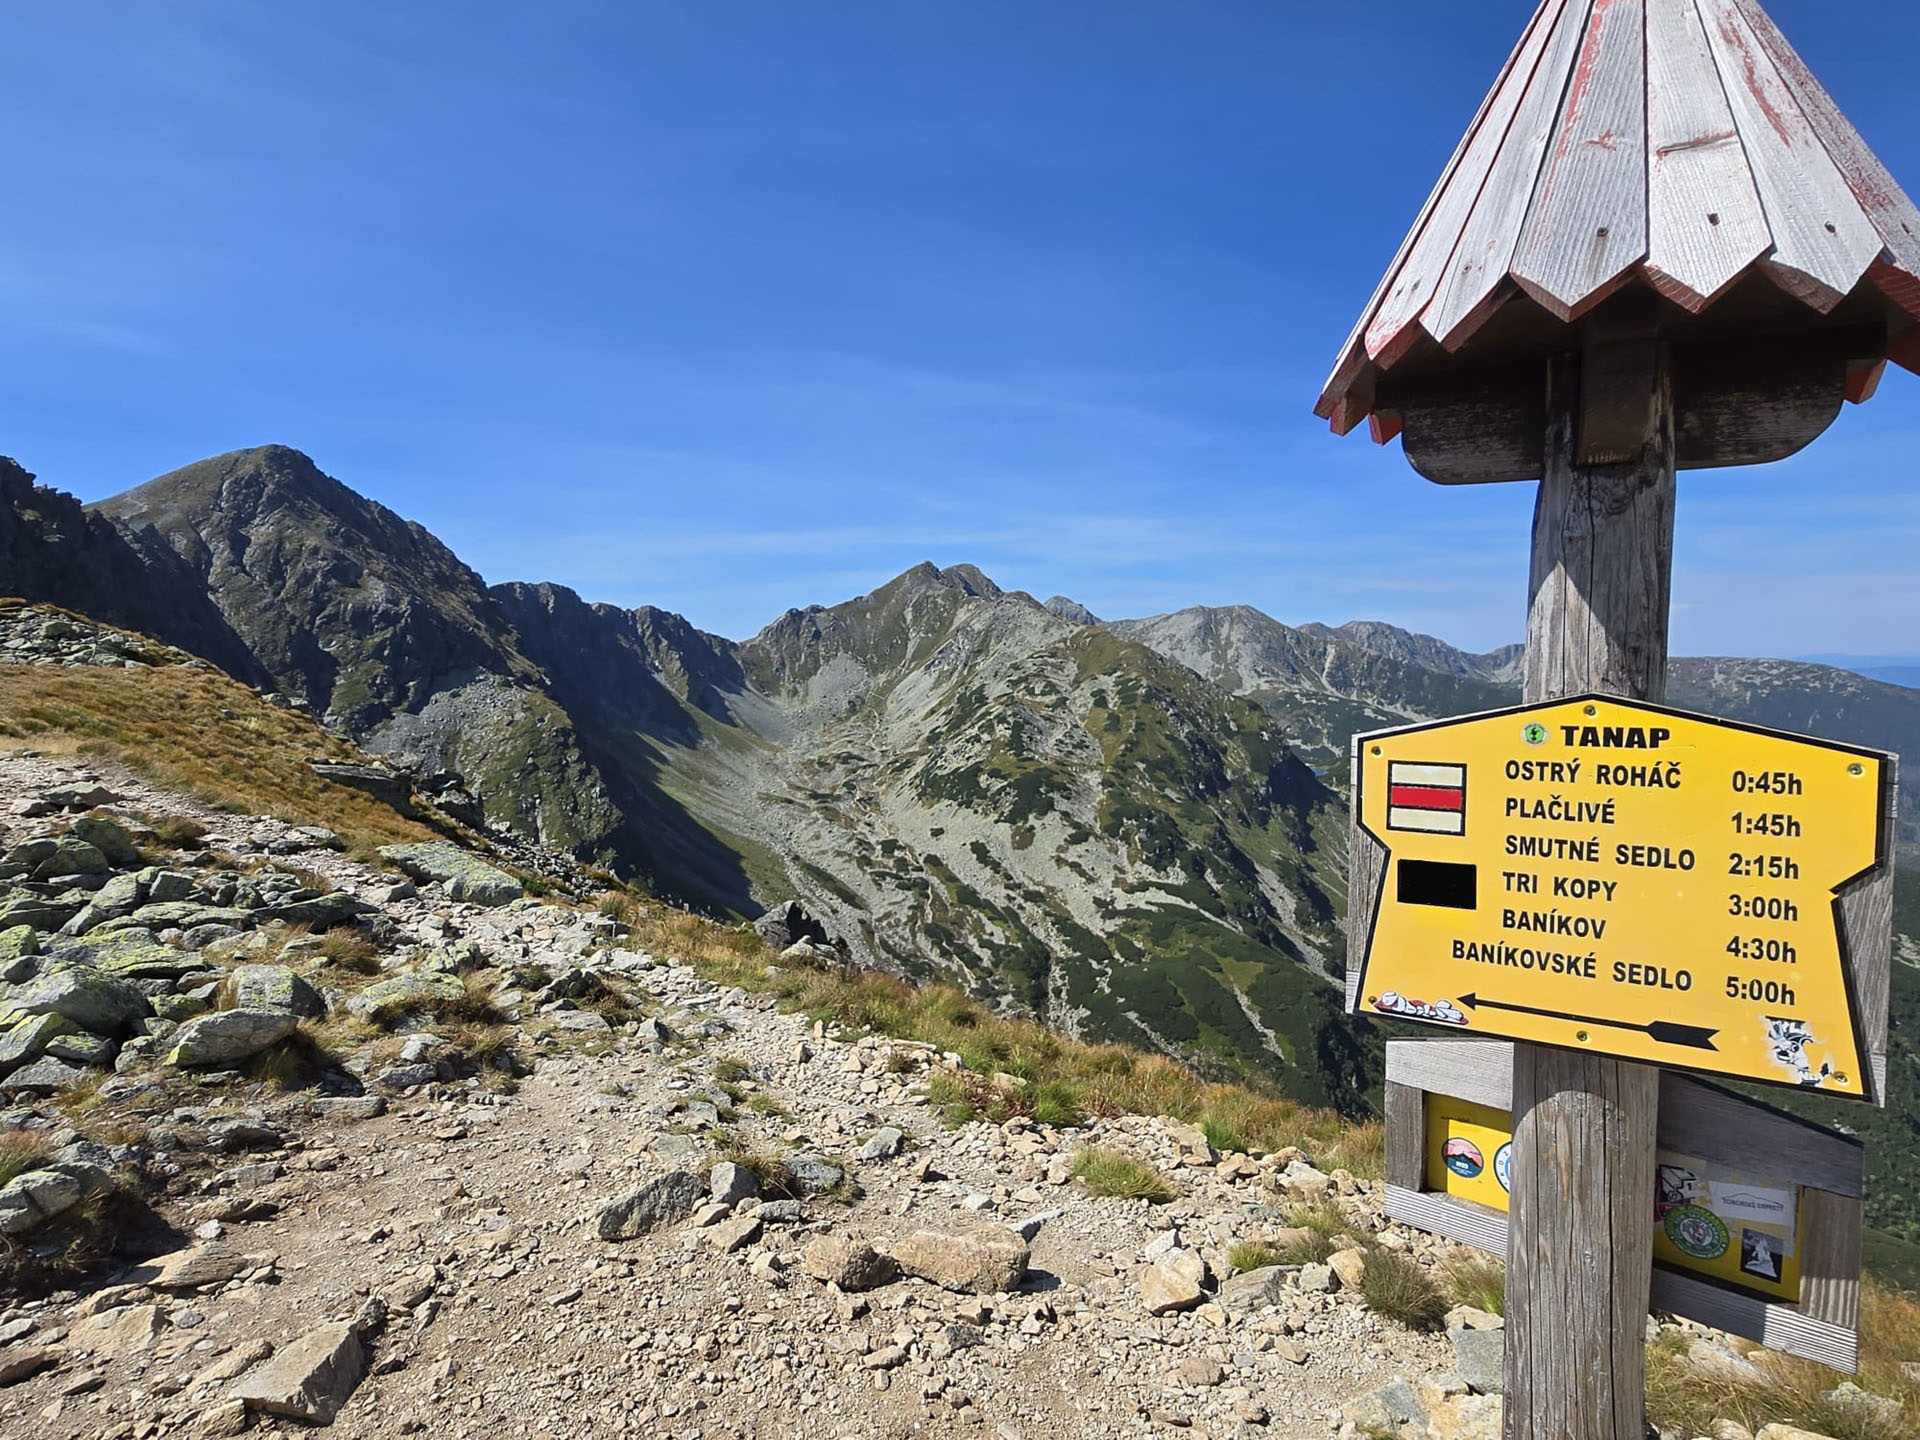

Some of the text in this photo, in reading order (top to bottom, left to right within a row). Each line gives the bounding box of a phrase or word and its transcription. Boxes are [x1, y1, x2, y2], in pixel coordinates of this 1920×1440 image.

[1560, 725, 1671, 749] TANAP
[1506, 756, 1680, 789] OSTRÝ ROHÁČ
[1732, 771, 1802, 795] 0:45h
[1506, 793, 1615, 824] PLAČLIVÉ
[1731, 811, 1801, 837] 1:45h
[1505, 835, 1695, 871] SMUTNÉ SEDLO
[1729, 853, 1799, 880] 2:15h
[1502, 871, 1618, 902] TRI KOPY
[1728, 894, 1798, 922] 3:00h
[1502, 909, 1606, 940] BANÍKOV
[1726, 935, 1797, 964] 4:30h
[1452, 939, 1693, 992] BANÍKOVSKÉ SEDLO
[1725, 976, 1795, 1006] 5:00h
